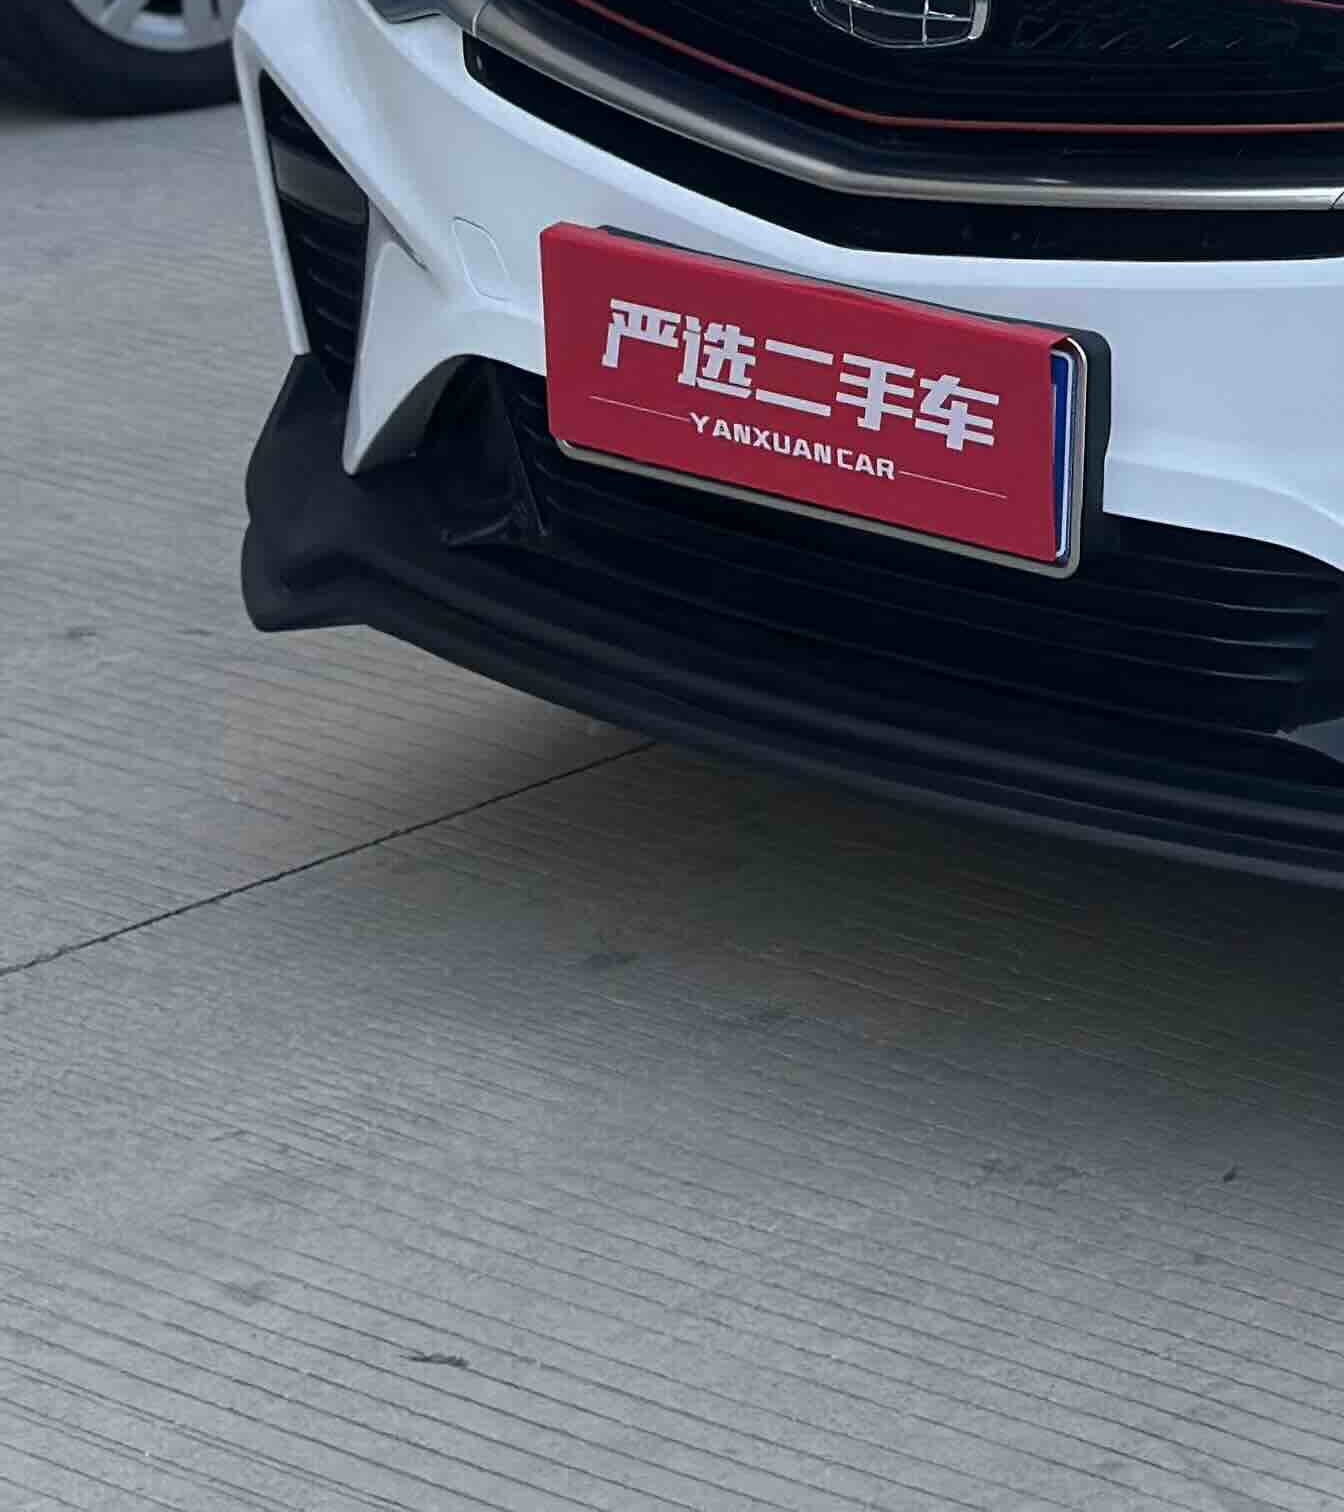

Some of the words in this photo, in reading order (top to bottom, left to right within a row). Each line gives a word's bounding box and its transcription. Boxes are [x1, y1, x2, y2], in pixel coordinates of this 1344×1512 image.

[601, 298, 1000, 451] 严选二手车
